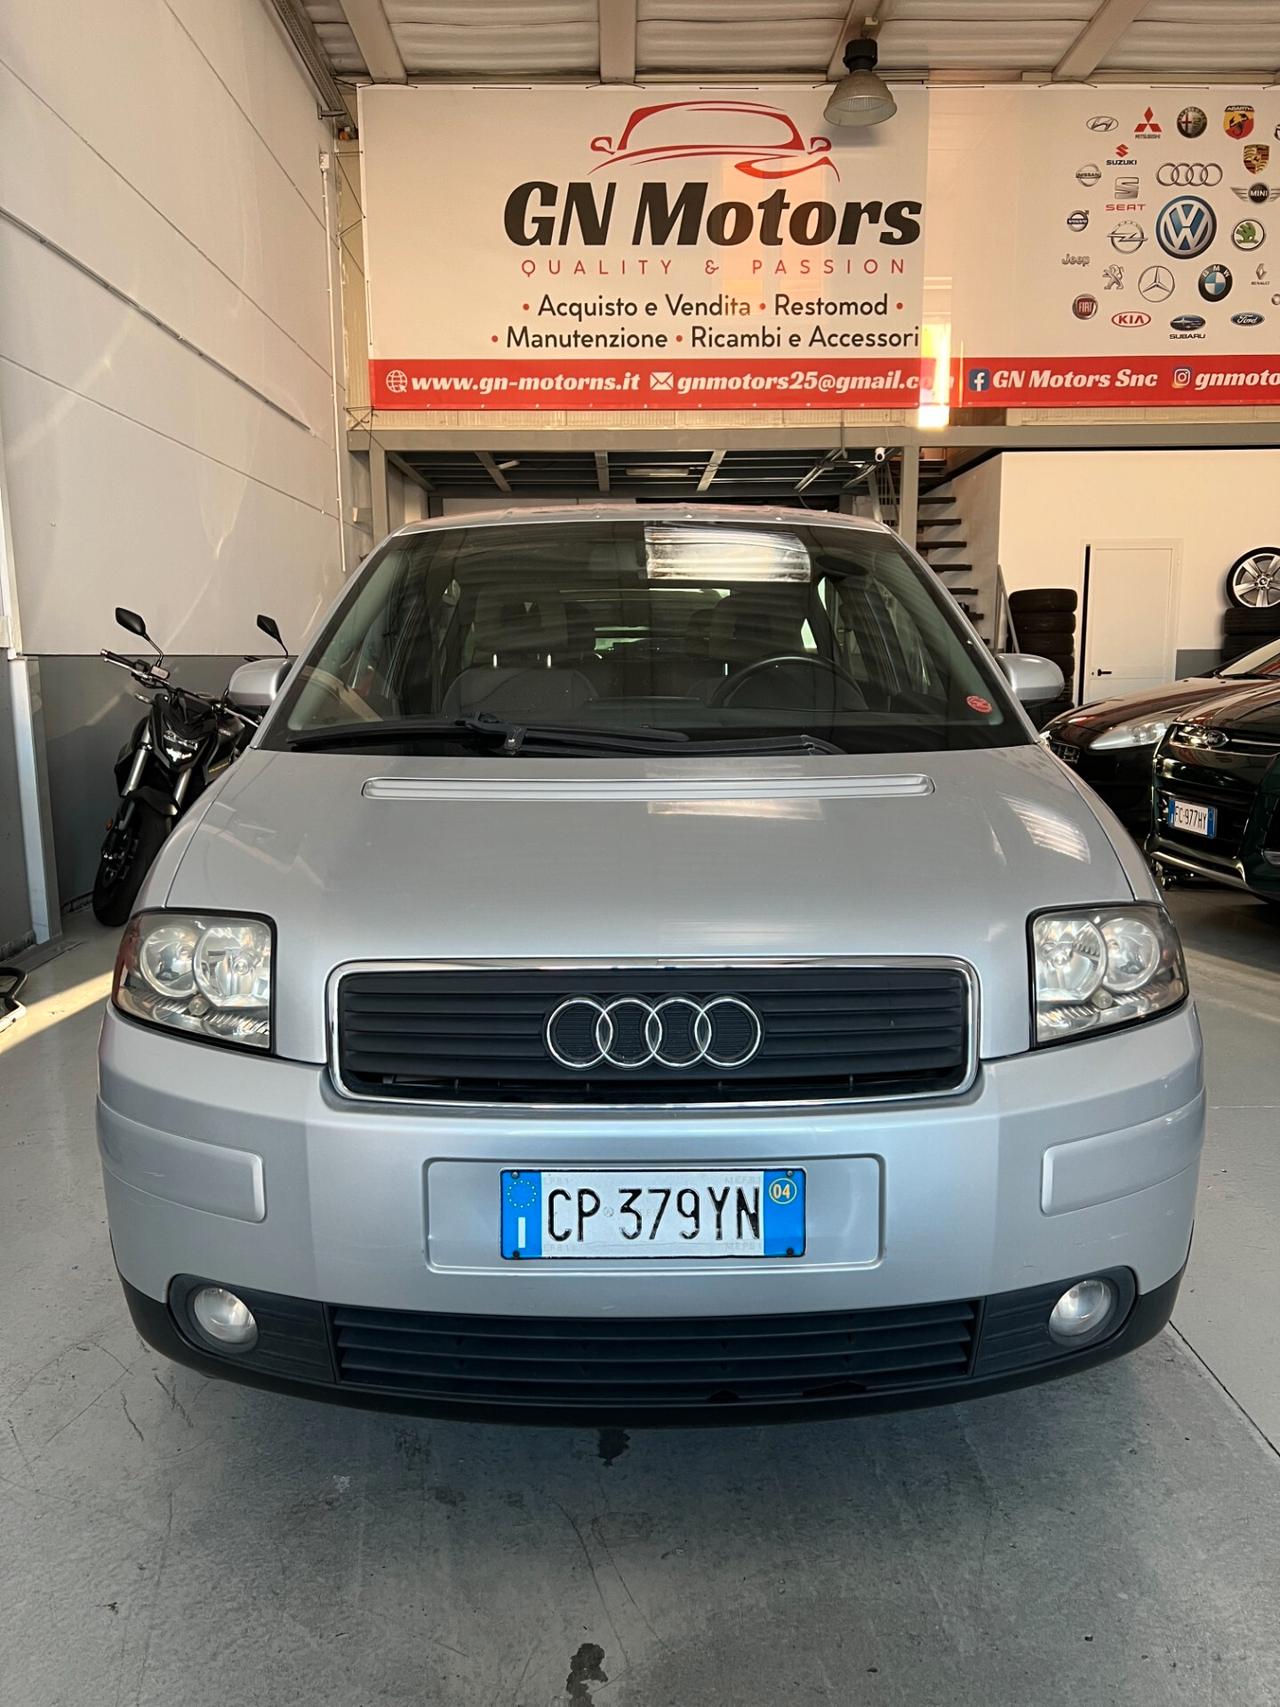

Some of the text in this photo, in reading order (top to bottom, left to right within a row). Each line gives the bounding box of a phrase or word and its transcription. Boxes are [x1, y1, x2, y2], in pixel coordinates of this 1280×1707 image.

[1250, 189, 1268, 198] MINI
[503, 181, 923, 247] GN Motors
[1105, 204, 1147, 212] SEAT
[521, 258, 905, 278] QUALITY & PASSION
[1061, 253, 1091, 267] Jeep
[537, 292, 889, 323] Acquisto e Vendita Restomod
[1078, 301, 1093, 314] FIAT
[1118, 315, 1145, 325] KIA
[506, 325, 920, 349] Manutenzione Ricambi e Accessori
[411, 371, 641, 395] www.gn-motorns.it
[992, 370, 1026, 389] GN
[1028, 370, 1112, 389] Motors
[1114, 368, 1159, 388] Snc
[773, 1183, 791, 1199] 04
[548, 1188, 601, 1242] CP
[618, 1186, 760, 1242] 379YN
